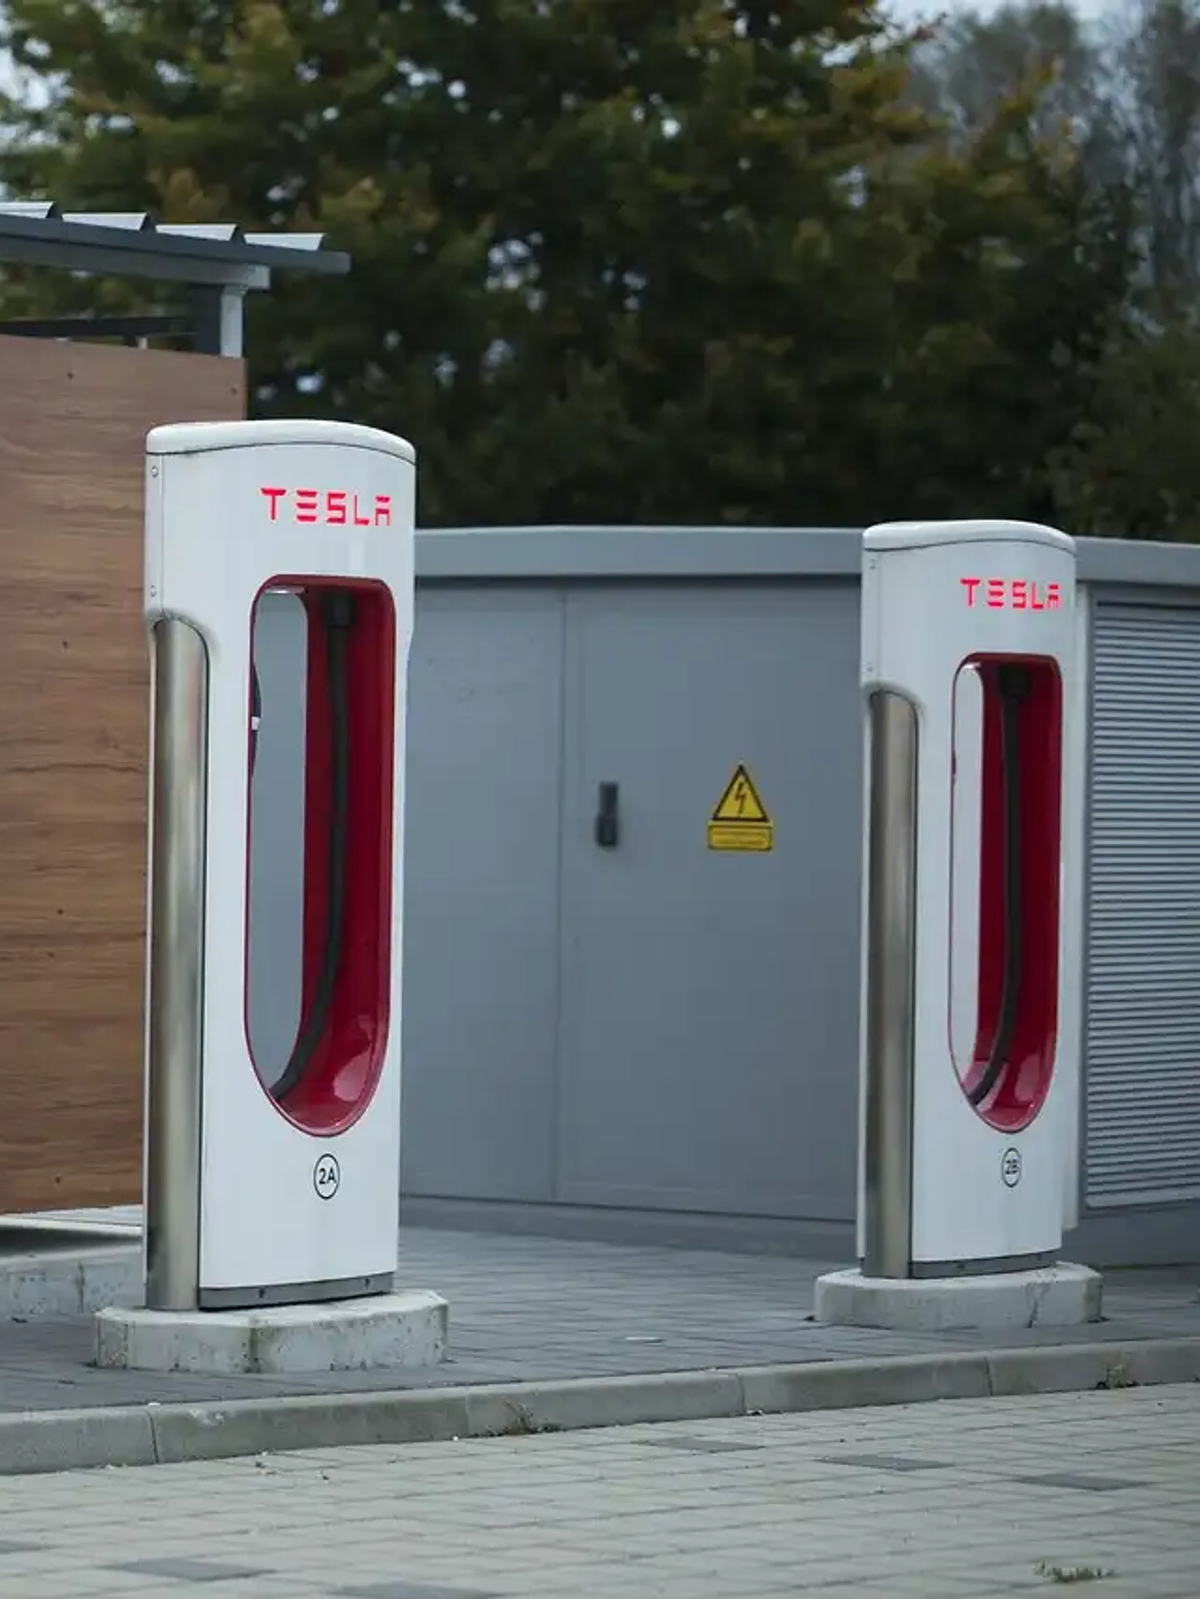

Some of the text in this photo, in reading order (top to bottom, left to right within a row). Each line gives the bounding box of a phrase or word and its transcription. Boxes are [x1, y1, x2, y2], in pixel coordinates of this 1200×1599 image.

[260, 487, 392, 527] TESLA
[960, 577, 1061, 611] TESLA
[318, 1167, 337, 1184] 2A
